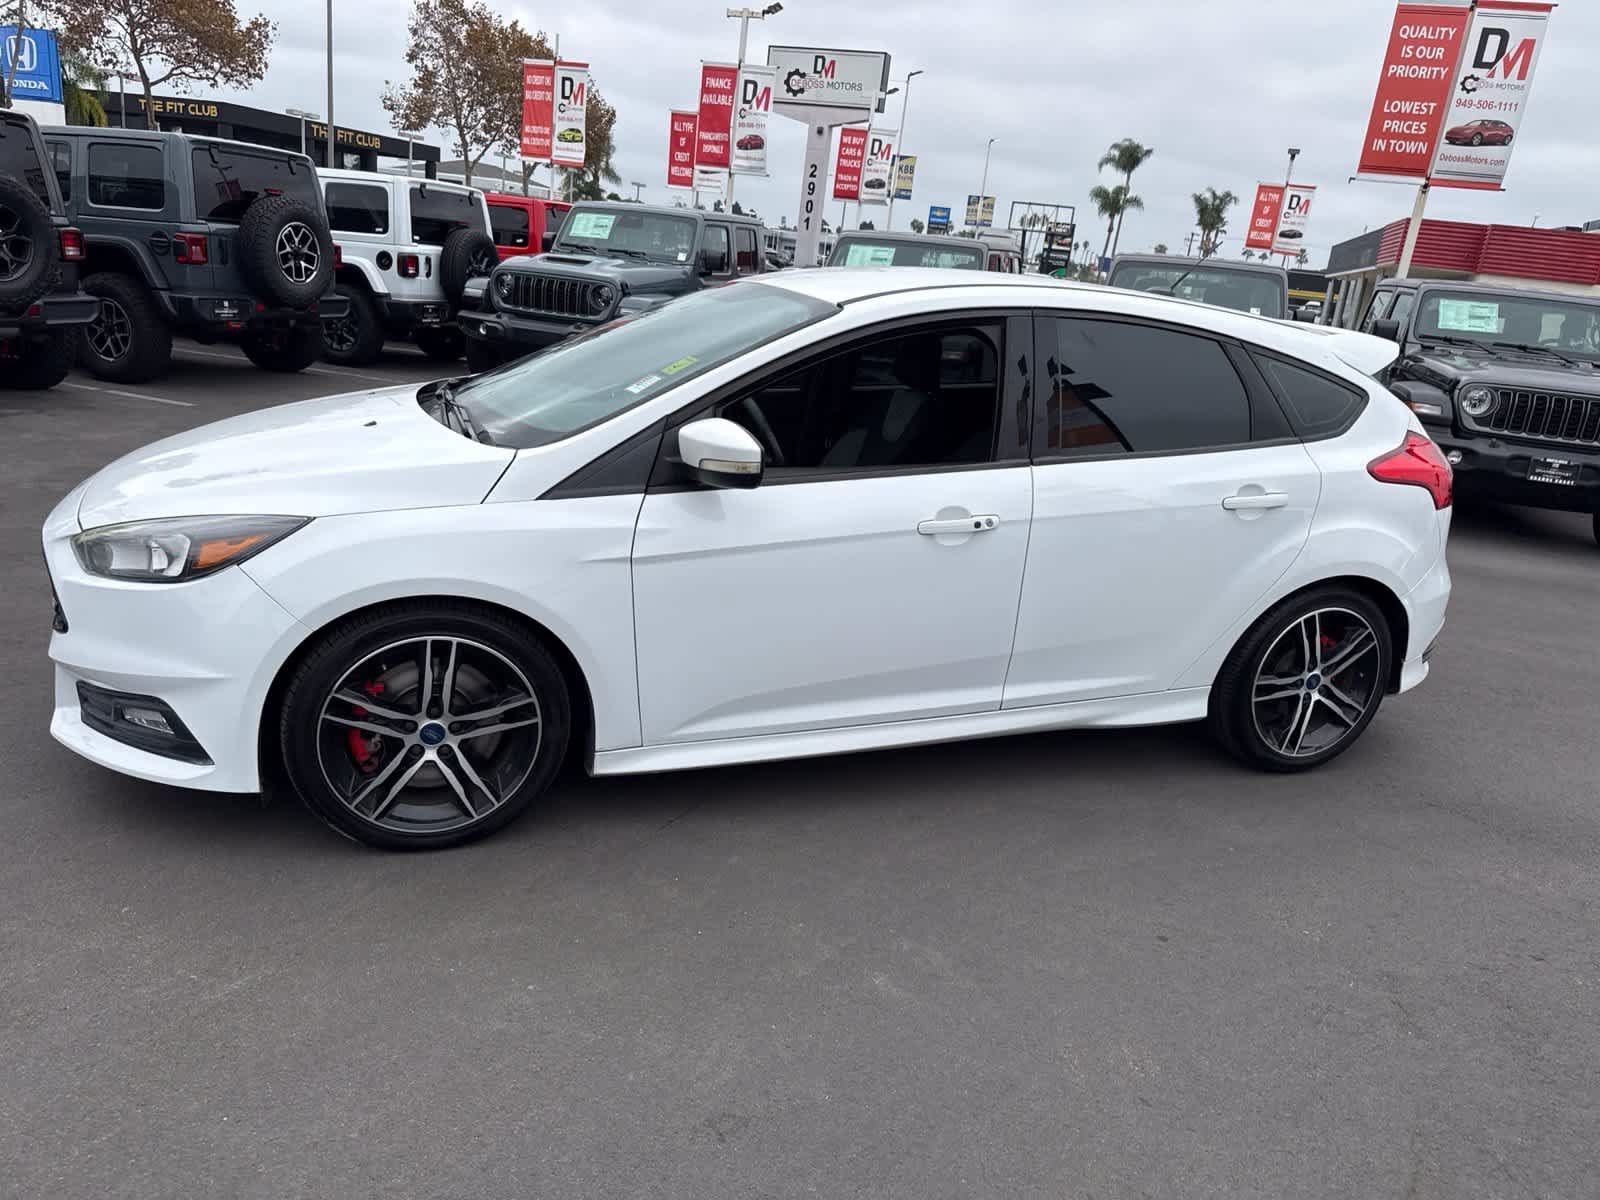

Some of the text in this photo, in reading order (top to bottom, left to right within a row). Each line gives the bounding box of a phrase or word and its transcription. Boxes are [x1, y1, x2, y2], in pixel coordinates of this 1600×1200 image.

[1400, 25, 1457, 40] QUALITY
[1401, 45, 1445, 60] IS OUR
[1472, 27, 1536, 81] DM
[813, 55, 836, 79] DM
[1388, 65, 1449, 80] PRIORITY
[705, 77, 732, 89] FINANCE
[791, 79, 863, 92] DEBOSS MOTORS
[561, 76, 585, 106] DM
[743, 79, 771, 112] DM
[702, 93, 733, 106] AVAILABLE
[1456, 98, 1518, 112] 949-506-1111
[139, 99, 218, 117] TE FIT CLUB
[1384, 100, 1437, 115] LOWEST
[1383, 120, 1427, 134] PRICES
[312, 124, 381, 149] TH FIT CLUB
[842, 136, 864, 145] WE BUY
[841, 147, 856, 156] CARS
[870, 138, 892, 161] DM
[1372, 138, 1428, 154] IN TOWN
[674, 152, 690, 162] CREDIT
[840, 159, 860, 168] TRUCKS
[671, 166, 693, 177] WELCOME
[803, 163, 817, 231] 2901
[1288, 194, 1310, 215] DM
